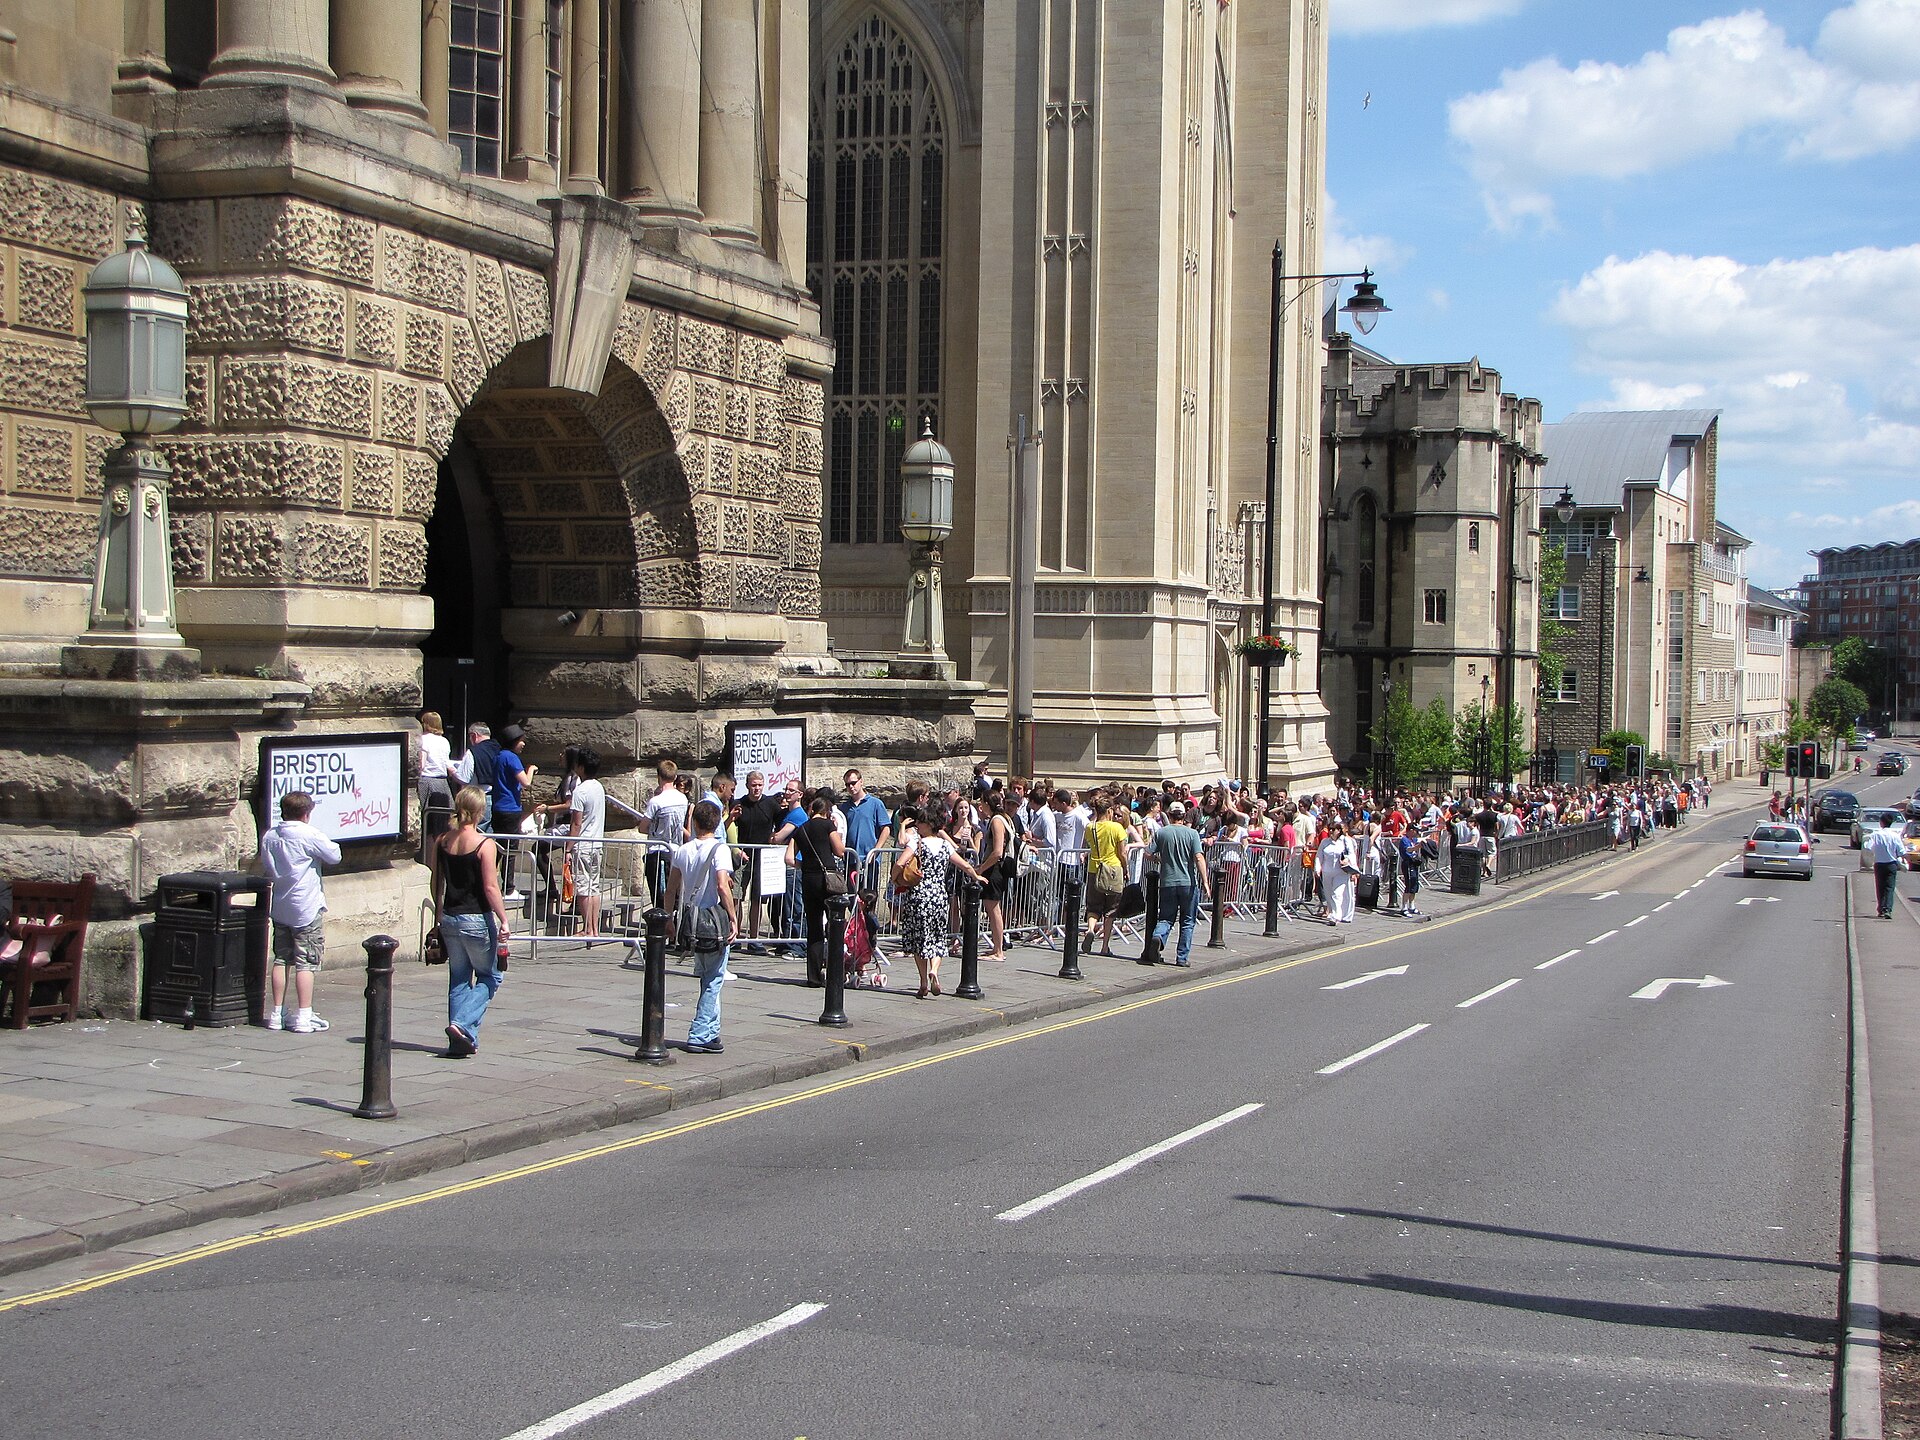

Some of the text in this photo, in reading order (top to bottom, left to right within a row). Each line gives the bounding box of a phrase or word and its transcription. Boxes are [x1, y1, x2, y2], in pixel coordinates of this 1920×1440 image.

[735, 732, 776, 748] BRISTOL
[273, 752, 353, 775] BRISTOL
[735, 748, 777, 765] MUSEUM
[273, 774, 355, 798] MUSEUM
